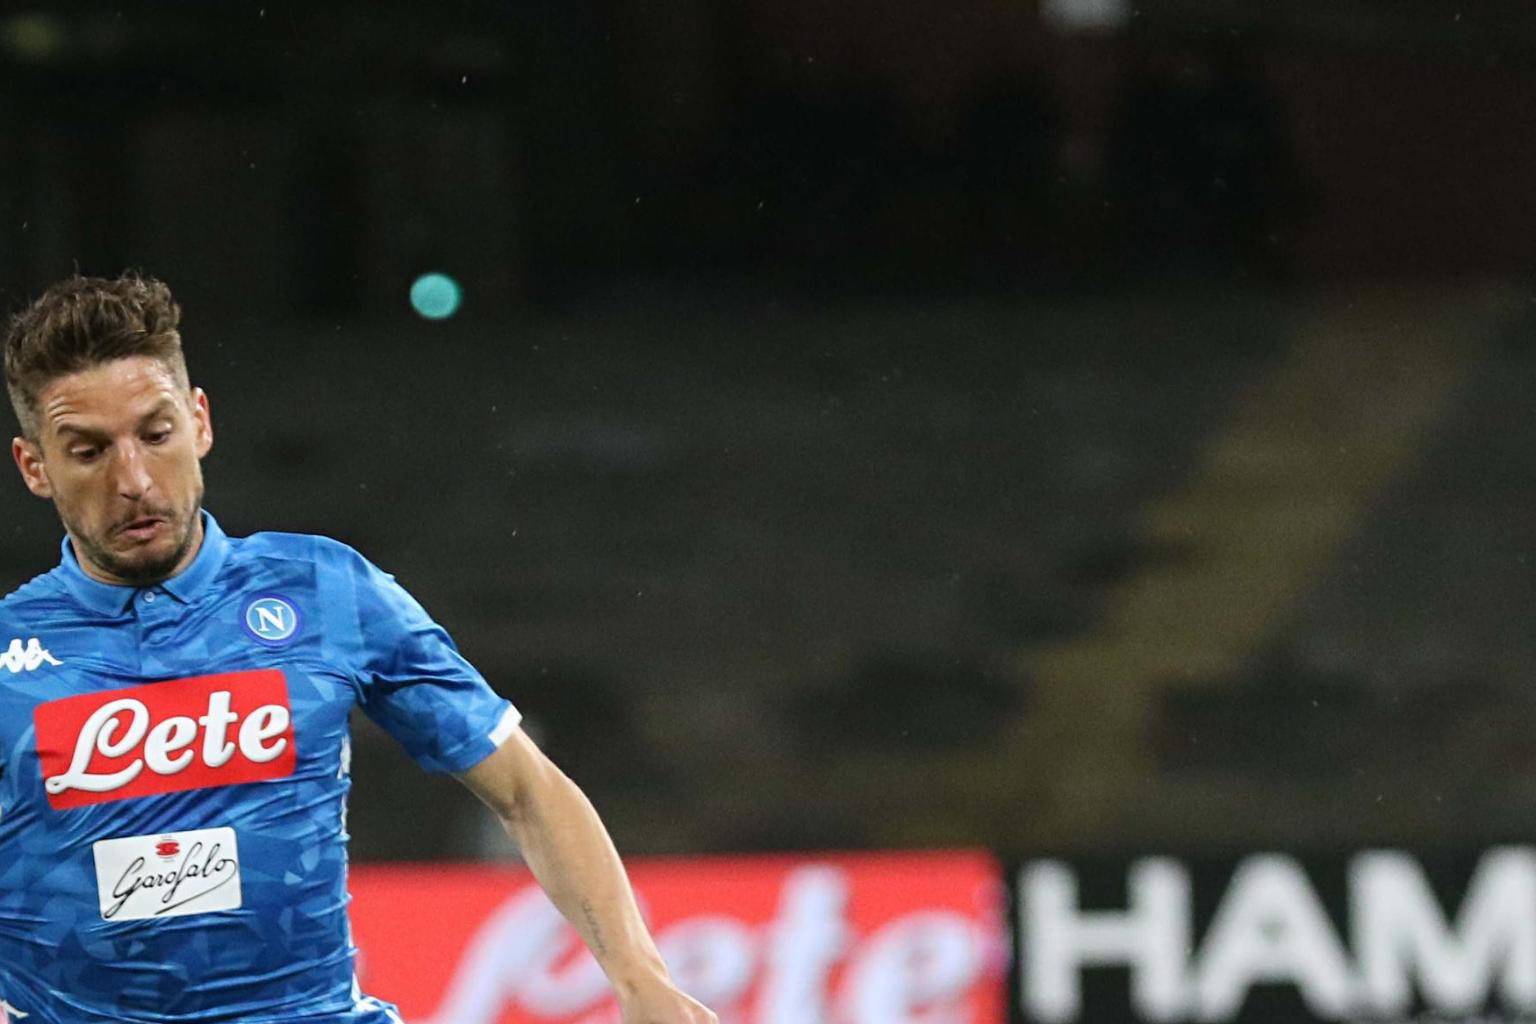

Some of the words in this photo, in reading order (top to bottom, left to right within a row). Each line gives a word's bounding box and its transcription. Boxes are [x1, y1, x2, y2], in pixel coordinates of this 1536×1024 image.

[254, 606, 285, 632] N
[44, 690, 291, 795] Lete
[101, 841, 237, 920] Garofalo
